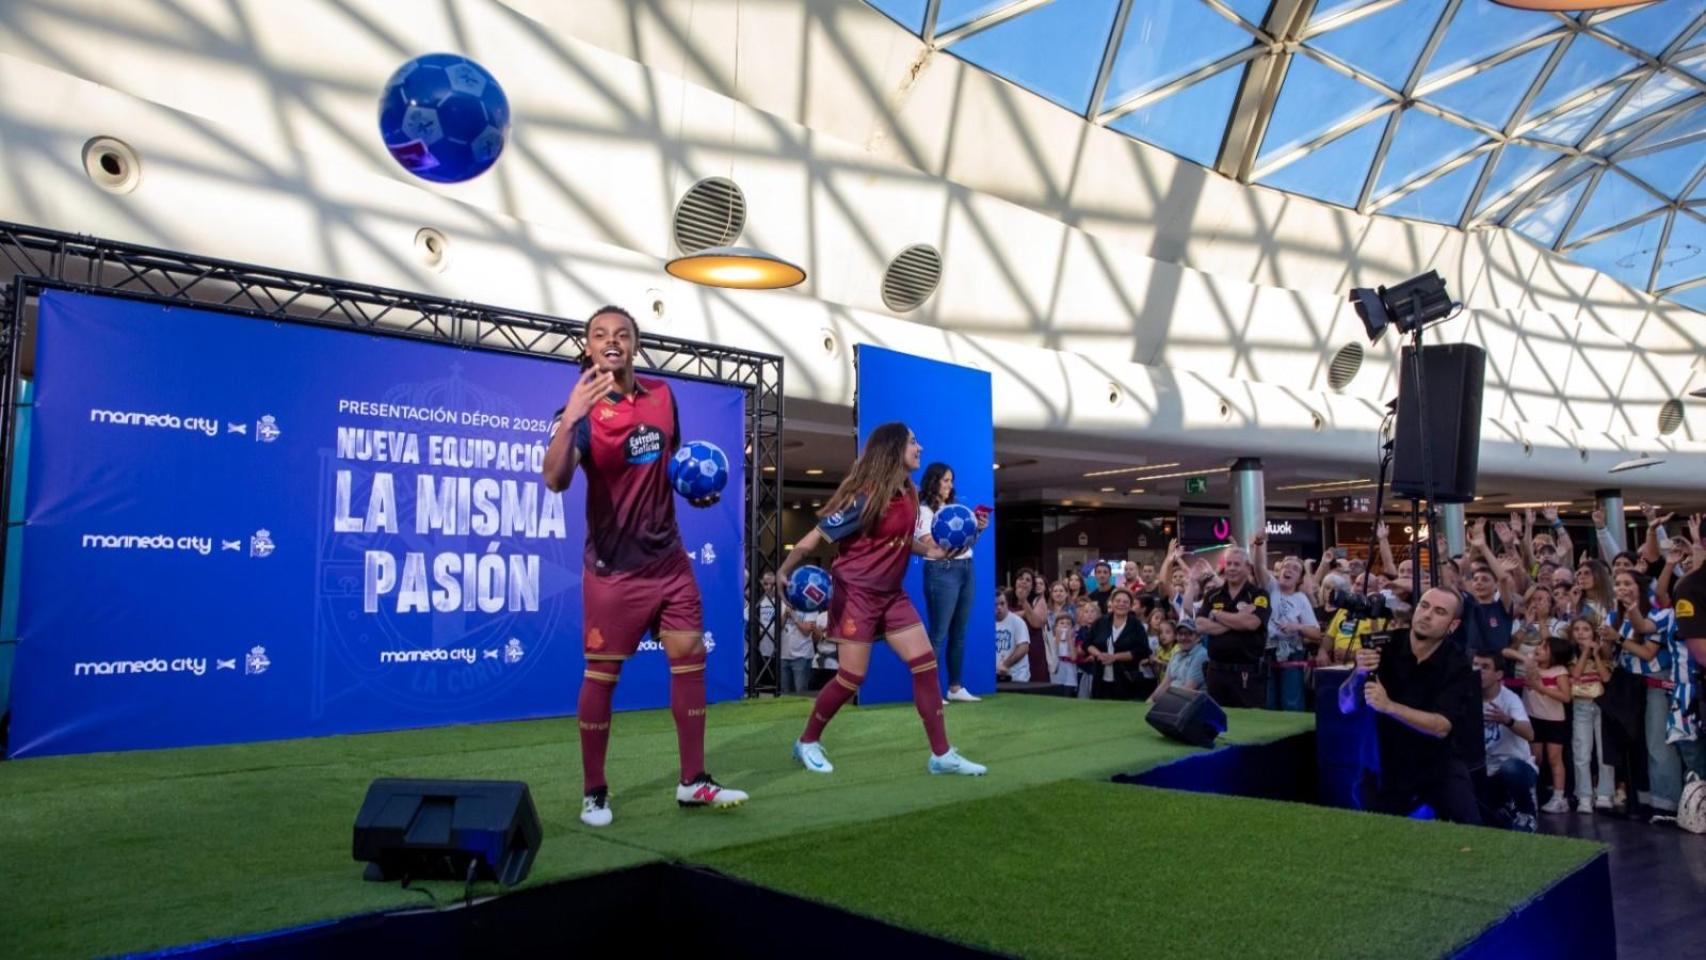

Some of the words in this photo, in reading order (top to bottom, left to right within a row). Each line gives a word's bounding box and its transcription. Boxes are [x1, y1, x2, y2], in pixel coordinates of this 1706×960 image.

[91, 409, 181, 428] marineda
[184, 416, 218, 436] city
[339, 399, 457, 424] PRESENTACIÓN
[462, 410, 509, 429] DÉPOR
[513, 417, 552, 434] 2025/
[336, 427, 420, 465] NUEVA
[429, 435, 548, 474] EQUIPACIÓ
[334, 470, 399, 534] LA
[416, 474, 567, 538] MISMA
[83, 534, 174, 550] marineda
[177, 536, 212, 555] city
[364, 541, 540, 614] PASIÓN
[75, 658, 168, 676] marineda
[171, 656, 207, 676] city
[380, 648, 449, 663] marineda
[450, 648, 477, 664] city
